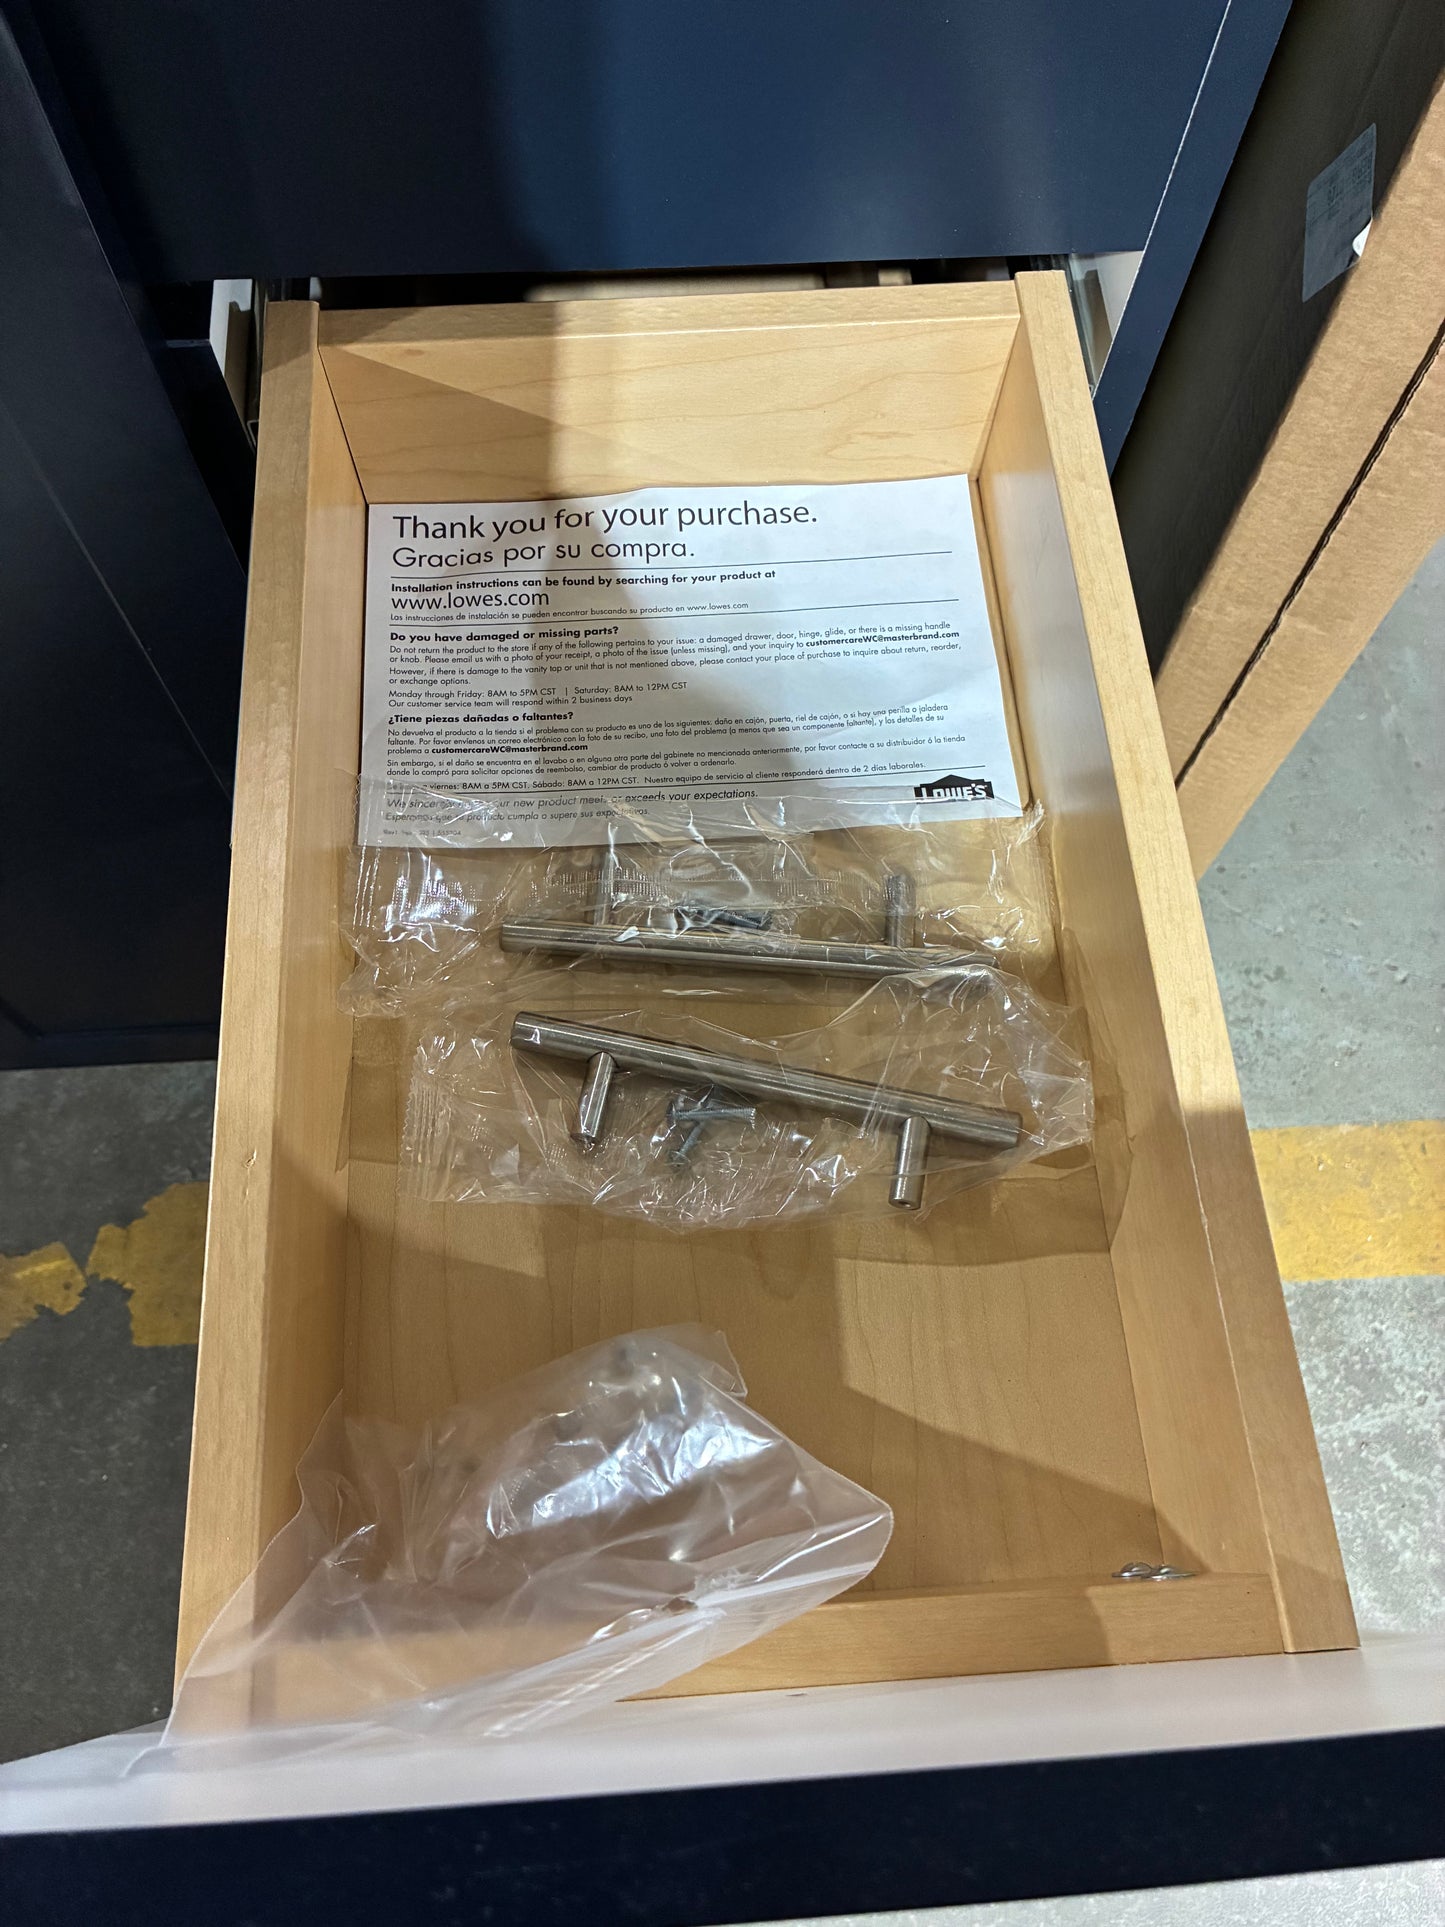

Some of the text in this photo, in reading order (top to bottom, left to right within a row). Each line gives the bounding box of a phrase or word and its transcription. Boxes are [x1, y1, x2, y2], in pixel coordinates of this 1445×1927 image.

[393, 500, 817, 542] Thank you for your purchase.
[393, 542, 694, 568] Gracias por su compra.
[391, 570, 776, 593] Installation instructions can be found by searching for your product at
[390, 612, 403, 621] Las
[405, 612, 454, 622] instrucciones
[455, 612, 466, 621] de
[468, 610, 509, 620] instalación
[521, 609, 551, 621] pueden
[552, 608, 588, 618] encontrar
[590, 607, 628, 617] buscando
[639, 605, 674, 617] producto
[686, 601, 749, 611] www.lowes.com
[391, 592, 550, 610] www.lowes.com
[389, 644, 401, 654] Do
[403, 644, 416, 654] not
[417, 644, 440, 654] return
[442, 644, 454, 654] the
[456, 643, 486, 656] product
[487, 643, 495, 653] to
[496, 643, 509, 653] the
[510, 642, 529, 652] store
[531, 641, 537, 651] if
[538, 643, 553, 653] any
[554, 640, 563, 650] of
[564, 640, 576, 650] the
[578, 639, 613, 651] following
[615, 637, 646, 650] pertains
[646, 636, 655, 646] to
[656, 638, 673, 648] your
[675, 635, 696, 645] issue:
[705, 632, 743, 645] damaged
[744, 632, 774, 641] drawer,
[775, 630, 797, 640] door,
[798, 629, 822, 641] hinge,
[824, 627, 846, 640] glide,
[847, 628, 856, 636] or
[858, 625, 877, 635] there
[879, 624, 886, 634] is
[894, 622, 923, 634] missing
[924, 619, 951, 630] handle
[390, 632, 406, 641] Do
[410, 634, 429, 643] you
[435, 633, 462, 642] have
[466, 630, 519, 643] damaged
[539, 628, 581, 639] missing
[583, 626, 619, 637] parts?
[399, 653, 422, 663] knob.
[424, 654, 449, 663] Please
[451, 653, 473, 663] email
[474, 655, 483, 663] us
[485, 652, 501, 662] with
[511, 651, 534, 664] photo
[534, 651, 544, 661] of
[544, 652, 562, 663] your
[564, 649, 593, 661] receipt,
[602, 647, 625, 660] photo
[625, 647, 634, 657] of
[635, 646, 648, 656] the
[649, 646, 668, 656] issue
[670, 644, 696, 657] (unless
[697, 642, 732, 655] missing),
[731, 642, 748, 652] and
[748, 643, 766, 654] your
[768, 640, 795, 652] inquiry
[795, 639, 804, 649] to
[805, 629, 960, 646] customercareWC@masterbrand.com
[388, 679, 687, 701] Monday through Friday: 8AM to 5PM CST Saturday: 8AM to 12PM CST
[399, 676, 438, 688] exchange
[439, 675, 471, 687] options.
[388, 697, 404, 707] Our
[406, 698, 442, 708] customer
[444, 698, 472, 708] service
[473, 698, 493, 708] team
[495, 697, 509, 707] will
[511, 696, 544, 709] respond
[545, 695, 569, 705] within
[579, 693, 612, 703] business
[613, 693, 633, 705] days
[388, 715, 422, 725] ¿Tiene
[425, 714, 460, 725] piezas
[463, 713, 509, 723] dañadas
[522, 712, 574, 722] faltantes?
[387, 745, 422, 758] problema
[431, 742, 588, 754] customercareWC@masterbrand.com
[461, 779, 482, 789] 8AM
[491, 779, 510, 789] 5PM
[567, 777, 587, 787] 8AM
[597, 776, 620, 786] 12PM
[644, 774, 674, 784] Nuestro
[675, 772, 702, 785] equipo
[703, 772, 714, 782] de
[715, 770, 744, 781] servicio
[745, 770, 754, 780] al
[754, 769, 779, 779] cliente
[781, 766, 824, 780] responderá
[824, 765, 850, 775] dentro
[851, 764, 861, 774] de
